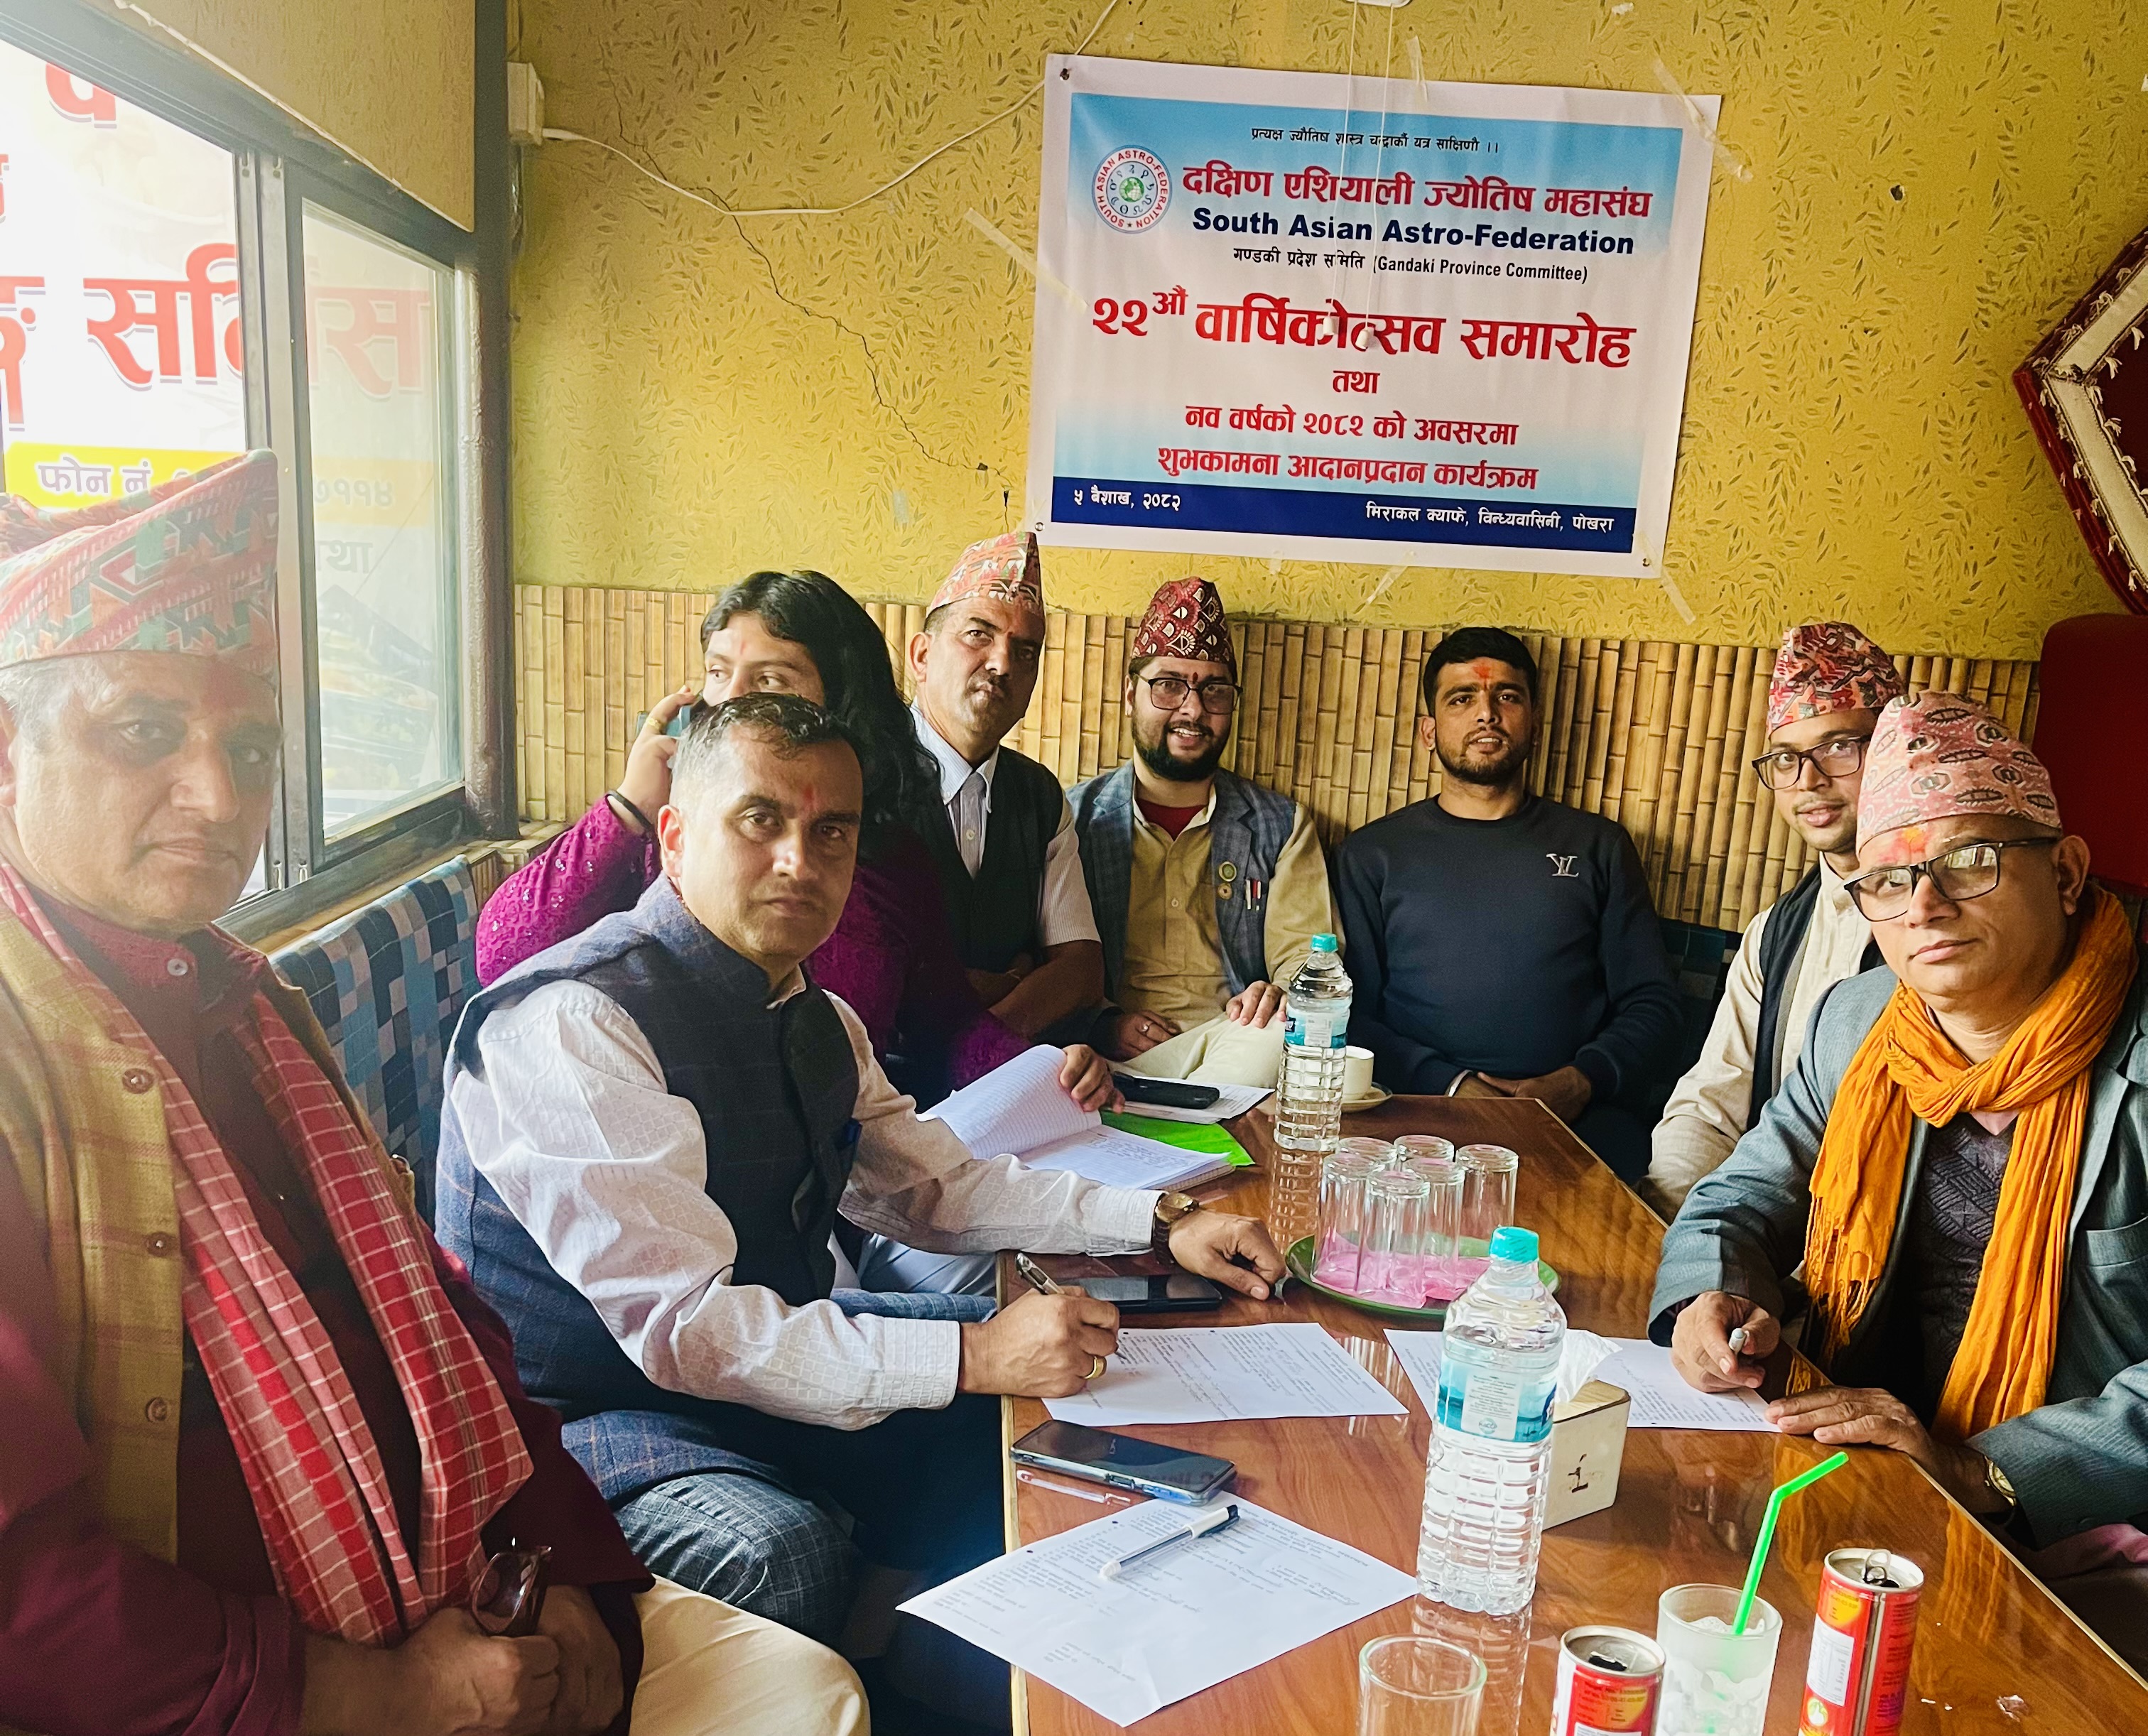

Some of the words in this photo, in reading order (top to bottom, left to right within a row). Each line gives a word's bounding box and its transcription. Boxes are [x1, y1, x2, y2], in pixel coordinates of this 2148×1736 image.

[1414, 137, 1431, 148] यत्र
[1436, 135, 1480, 151] साक्षिणौ
[1097, 158, 1115, 192] ASIAN
[1117, 150, 1168, 227] ASTRO-FEDERATION
[1183, 160, 1274, 197] दक्षिण
[1284, 166, 1415, 205] एशियाली
[1423, 175, 1536, 212] ज्योतिष
[1544, 186, 1654, 217] महासंघ
[1097, 195, 1124, 227] SOUTH
[1193, 207, 1279, 235] South
[1288, 214, 1372, 240] Asian
[1382, 219, 1634, 254] Astro-Federation
[1233, 246, 1281, 264] गण्डकी
[1287, 249, 1317, 267] प्रदेश
[1374, 255, 1434, 273] (Gandaki
[1440, 259, 1500, 276] Province
[1506, 262, 1588, 283] Committee)
[1460, 312, 1637, 368] समारोह
[1333, 370, 1380, 394] तथा
[1186, 406, 1222, 428] नव
[1229, 403, 1296, 433] वर्षको
[1303, 412, 1363, 436] २०८२
[1373, 411, 1407, 438] को
[1414, 418, 1519, 445] अवसरमा
[38, 456, 111, 493] फोन
[122, 461, 151, 491] नं
[1158, 447, 1281, 477] शुभकामना
[1288, 455, 1428, 484] आदानप्रदान
[1434, 460, 1539, 489] कार्यक्रम
[1074, 489, 1083, 505] ५
[1143, 493, 1181, 511] २०८२
[1366, 501, 1421, 521] मिराकल
[1426, 506, 1468, 526] क्याफे,
[1478, 507, 1563, 531] विन्ध्यवासिनी,
[1573, 513, 1614, 533] पोखरा
